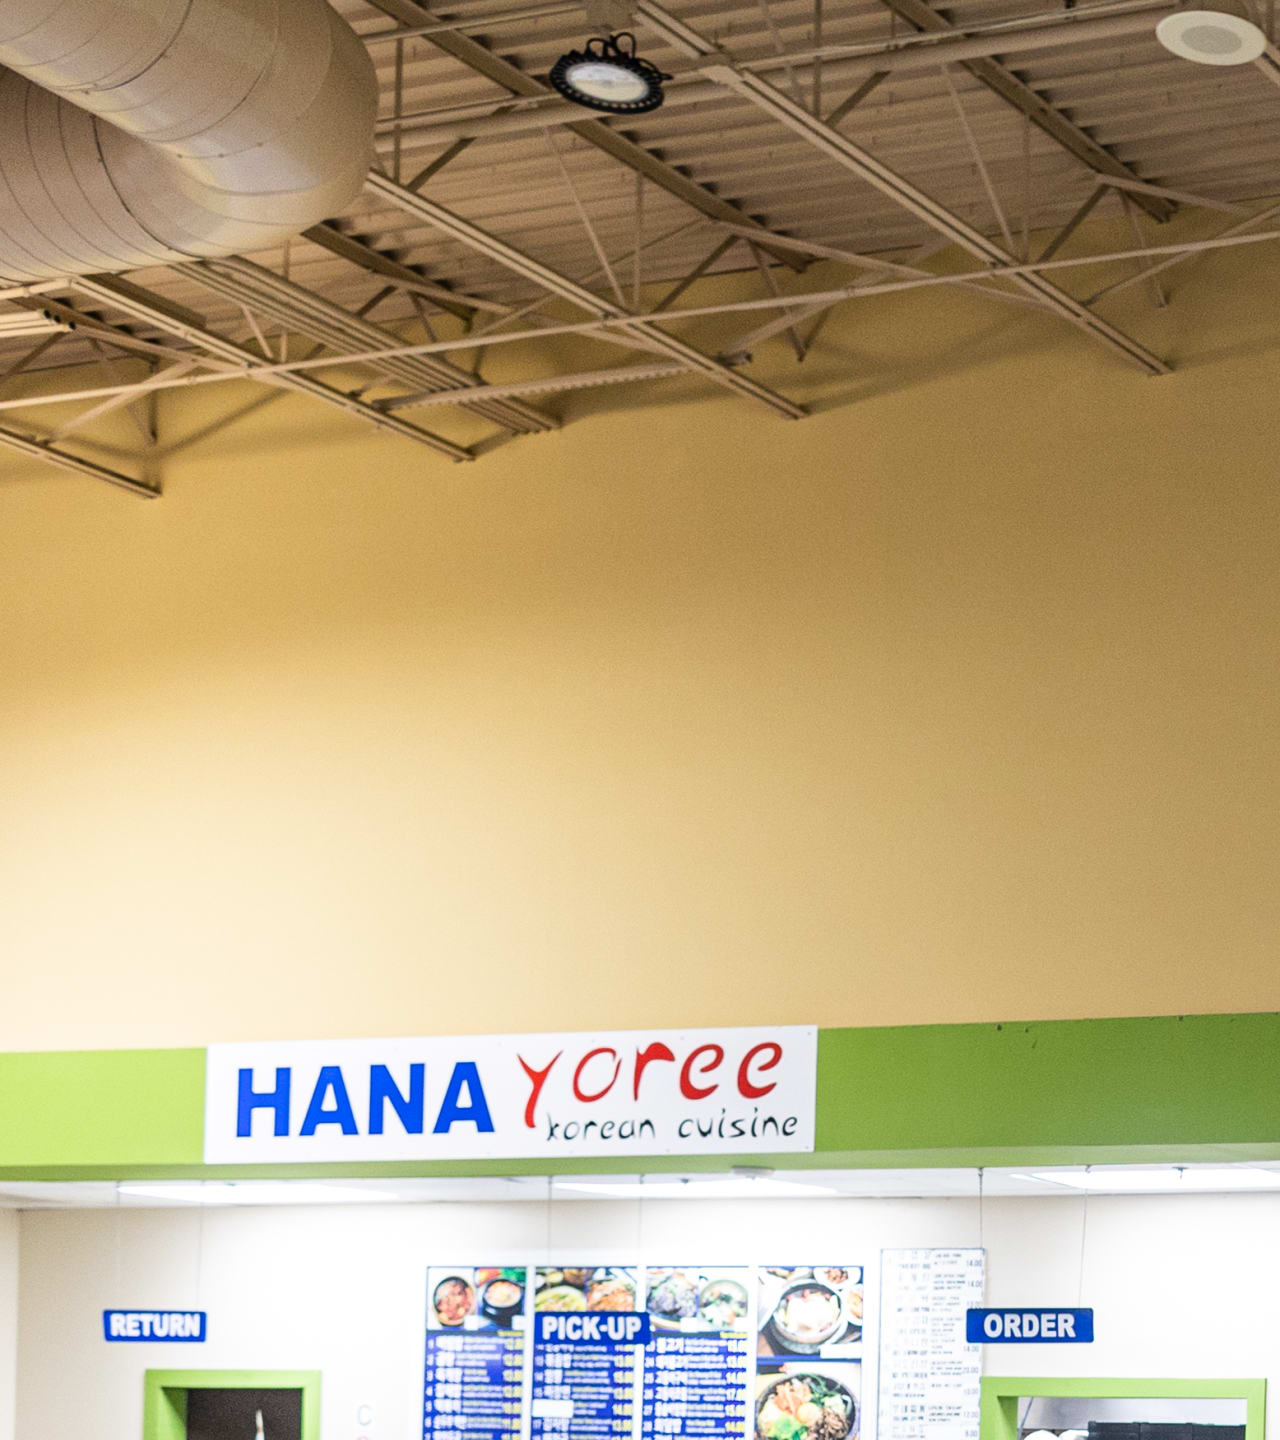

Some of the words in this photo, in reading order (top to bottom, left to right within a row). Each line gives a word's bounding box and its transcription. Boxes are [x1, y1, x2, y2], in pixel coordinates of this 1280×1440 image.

[236, 1061, 495, 1137] HANA
[547, 1111, 656, 1141] korean
[678, 1107, 798, 1138] cuisine
[110, 1313, 200, 1337] RETURN
[542, 1316, 641, 1340] PICK-UP
[983, 1313, 1075, 1338] ORDER
